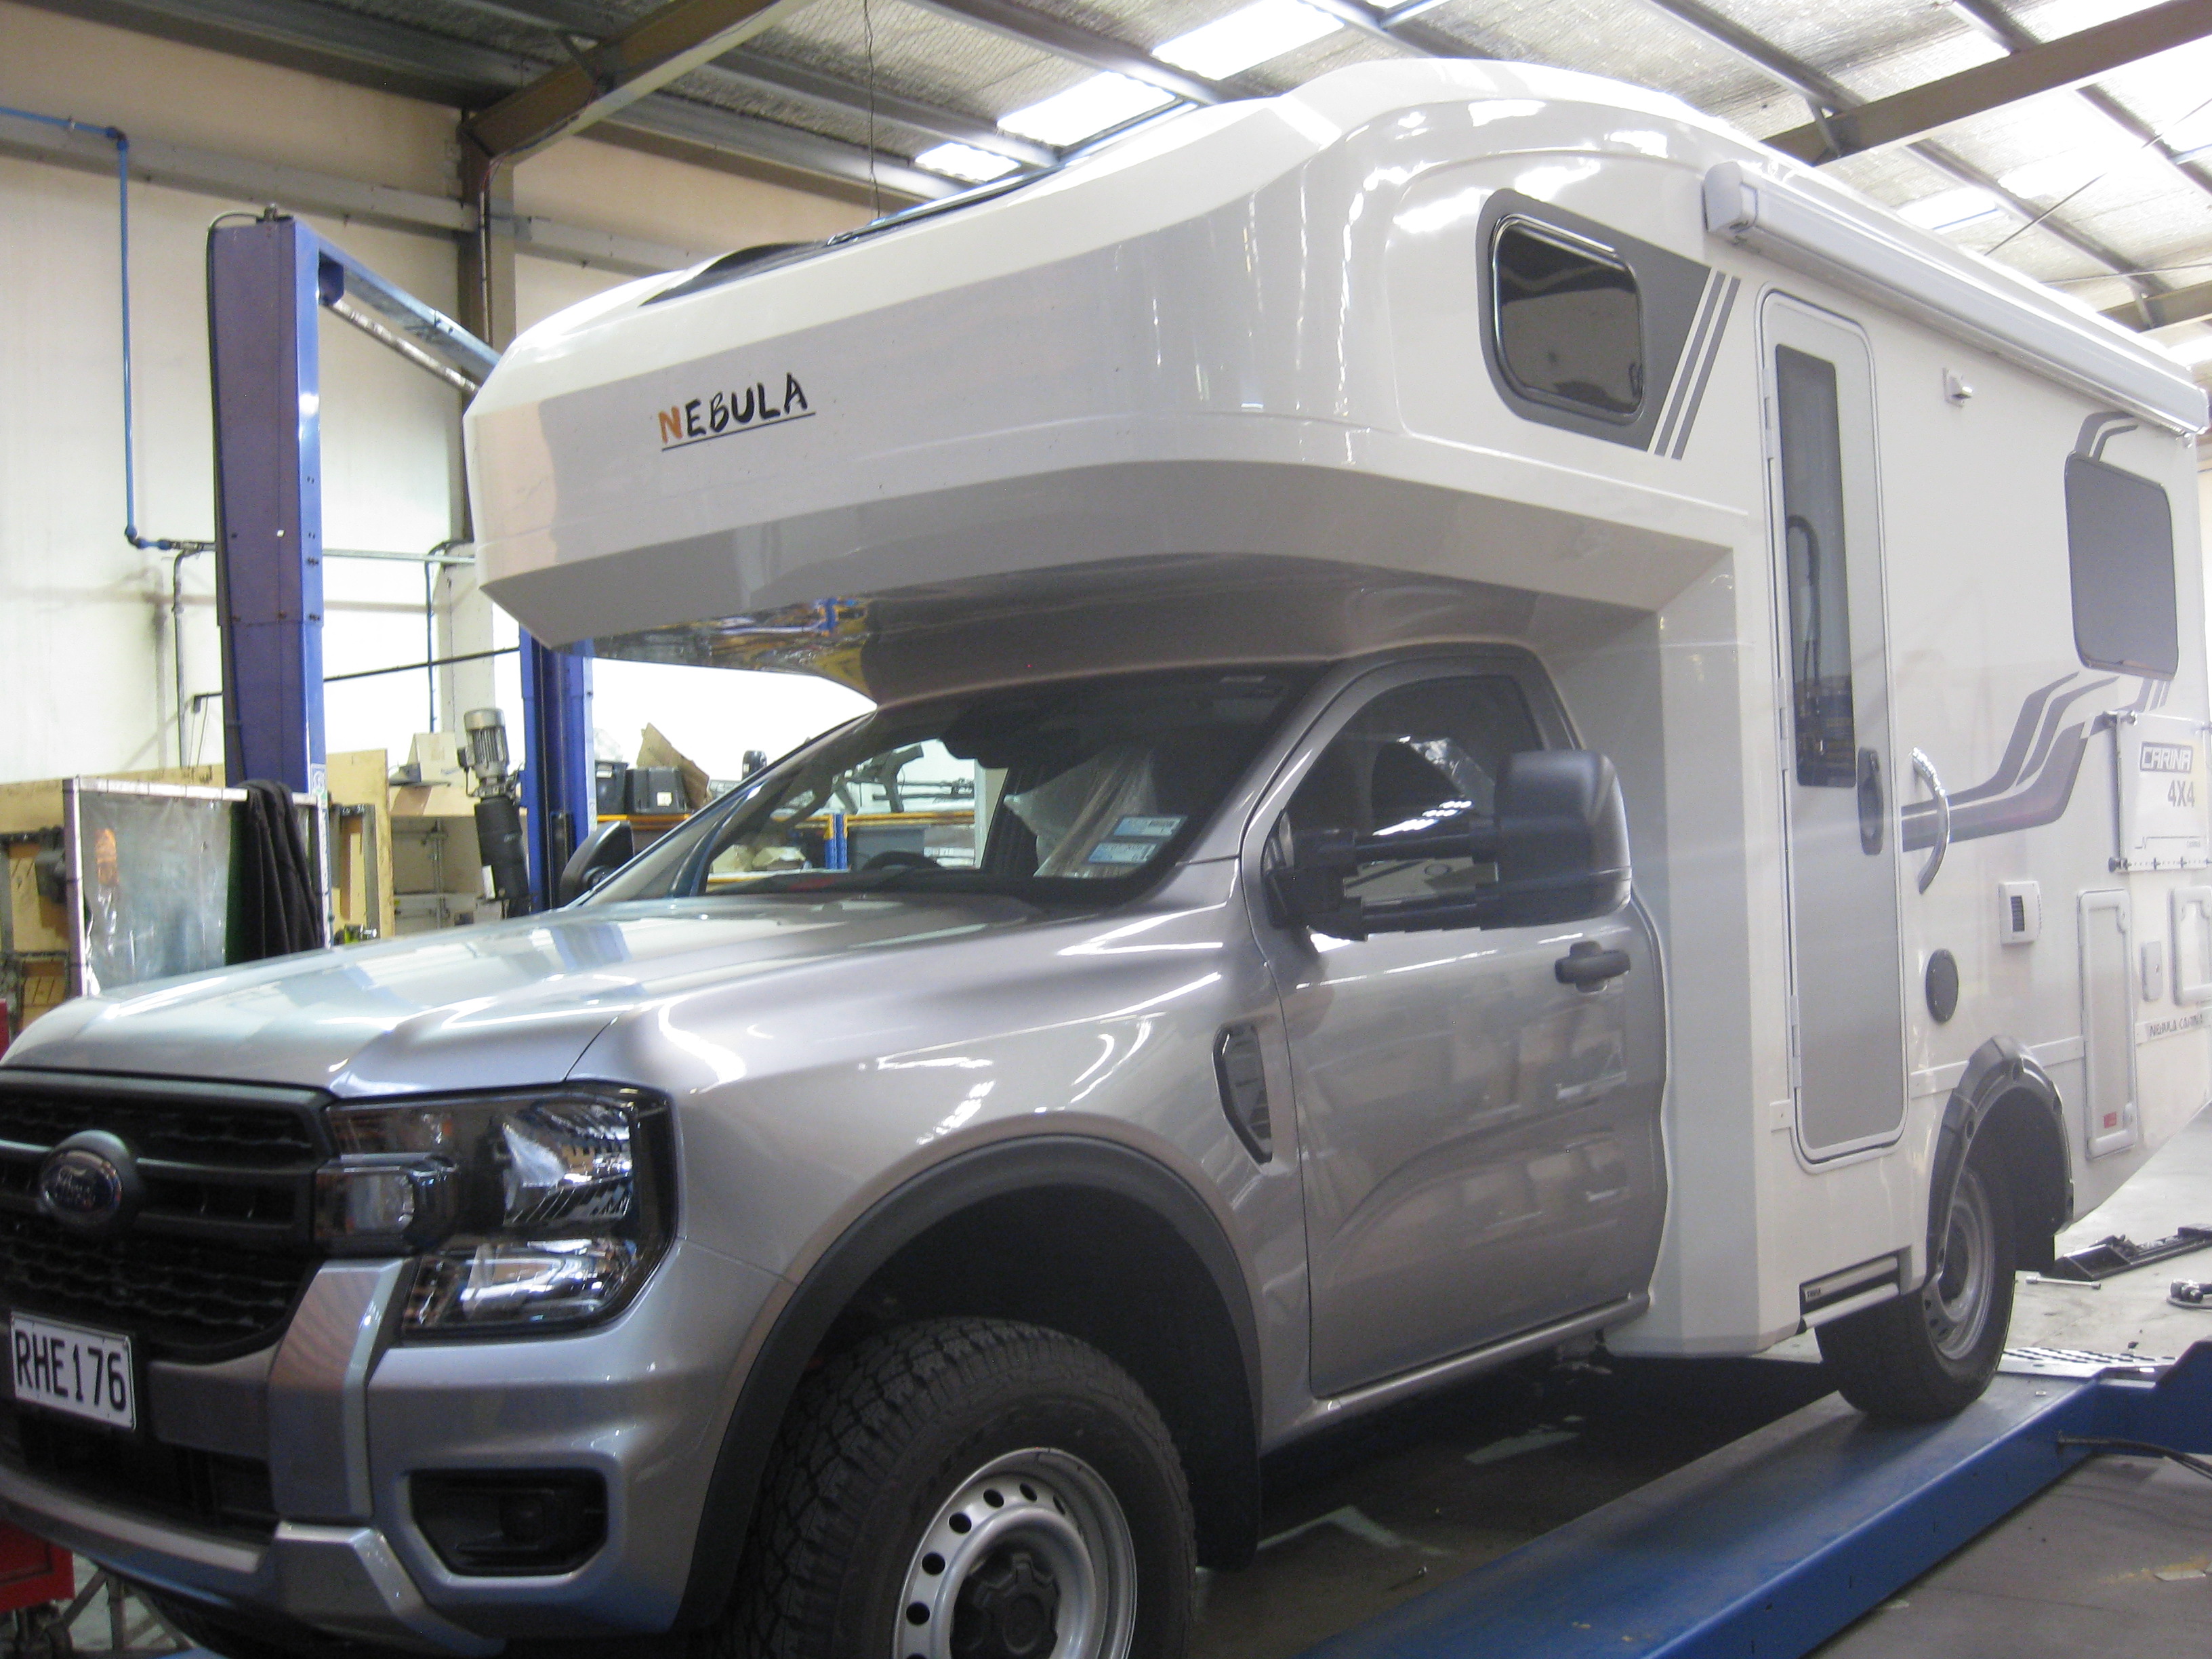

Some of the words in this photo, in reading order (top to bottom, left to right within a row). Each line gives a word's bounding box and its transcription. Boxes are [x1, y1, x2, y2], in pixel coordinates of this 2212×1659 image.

[658, 372, 808, 445] NEBULA
[2142, 745, 2193, 772] CARINA
[2168, 780, 2194, 807] 4X4
[15, 1329, 127, 1411] RHE176
